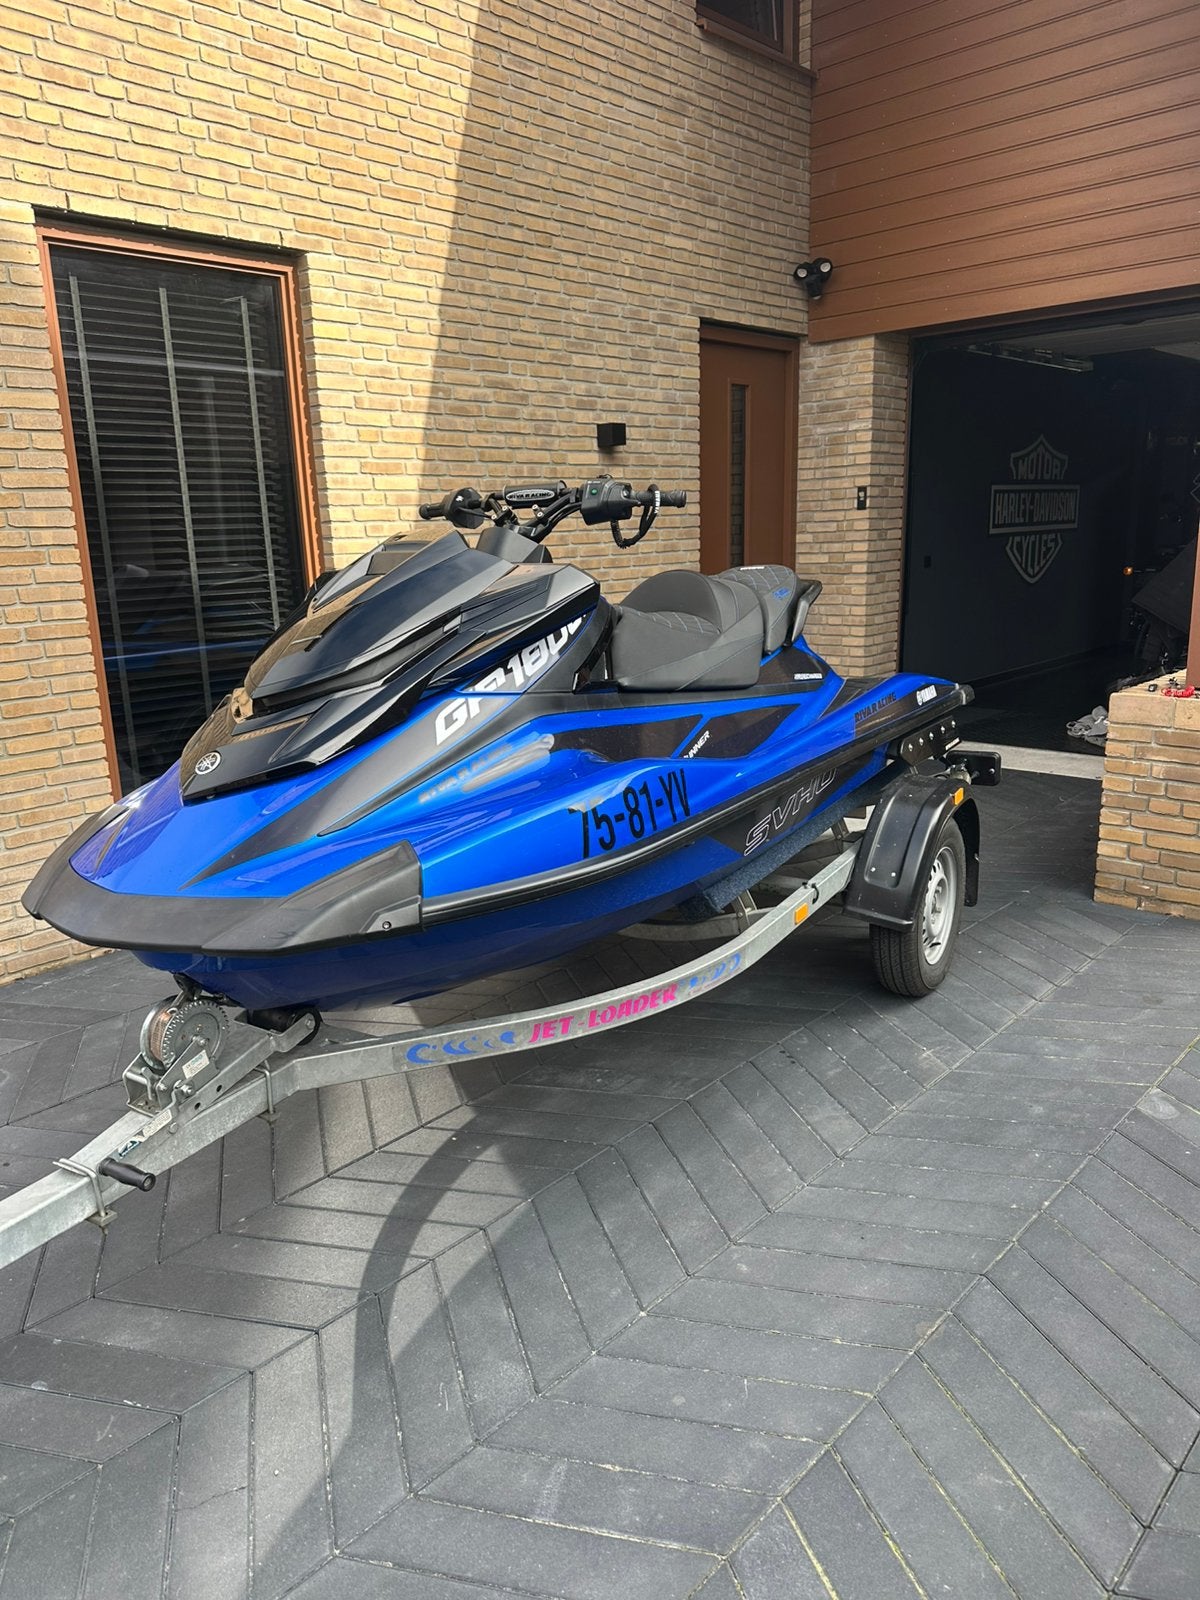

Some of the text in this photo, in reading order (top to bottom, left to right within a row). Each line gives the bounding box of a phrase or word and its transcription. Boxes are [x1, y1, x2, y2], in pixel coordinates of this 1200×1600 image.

[1018, 446, 1062, 480] MOTOR
[994, 492, 1077, 525] HARLEY-DAVIDSON
[1013, 533, 1056, 577] CYCLES
[567, 767, 691, 859] 75-81-YV
